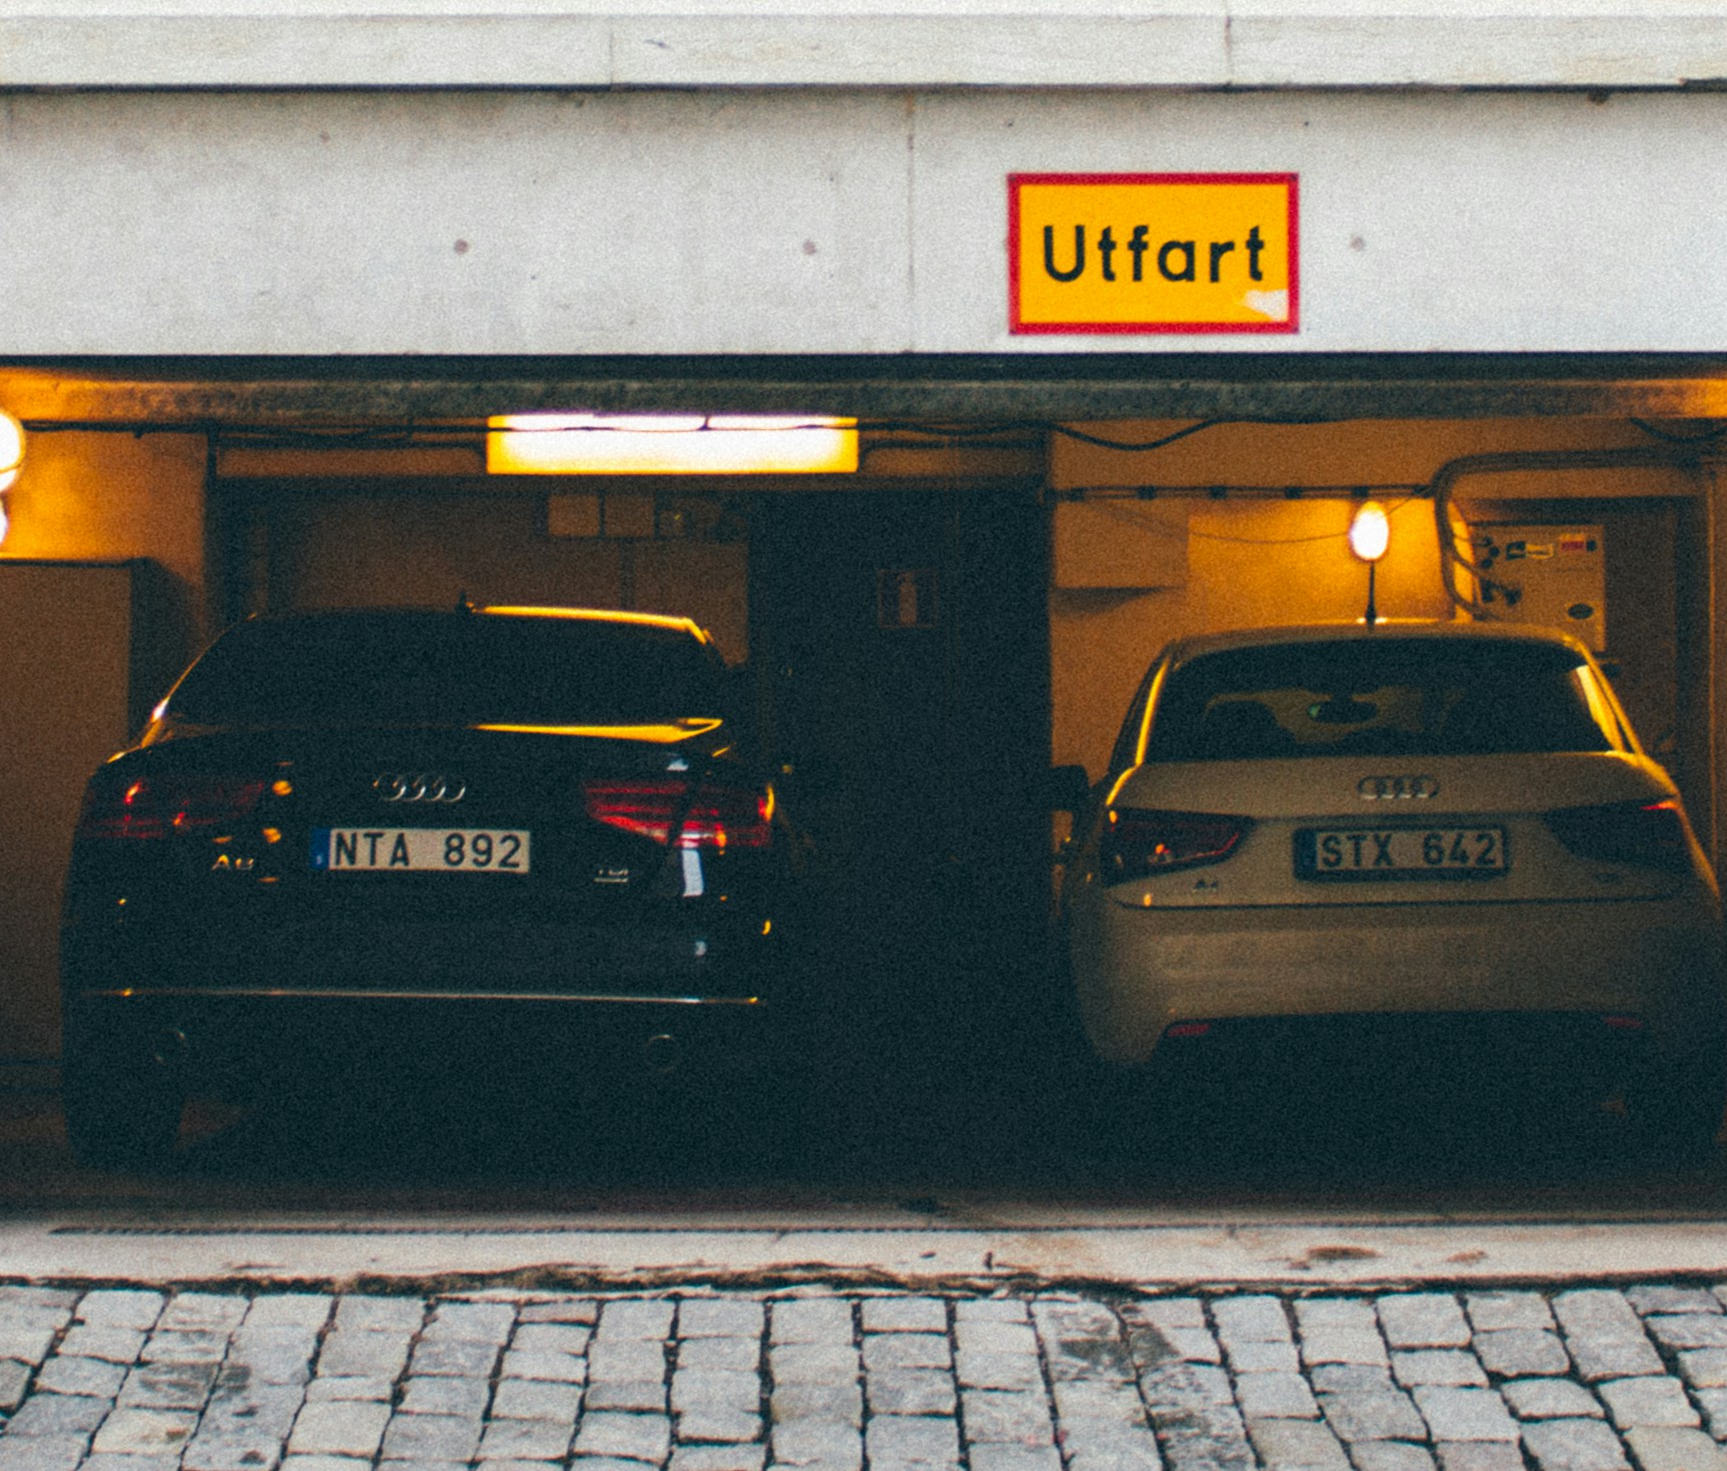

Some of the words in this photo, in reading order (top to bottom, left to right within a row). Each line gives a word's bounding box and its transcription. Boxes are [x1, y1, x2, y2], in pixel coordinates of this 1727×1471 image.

[1043, 224, 1265, 283] Utfart
[335, 832, 410, 867] NTA
[443, 832, 522, 869] 892
[1322, 833, 1393, 868] STX
[1423, 832, 1497, 866] 642
